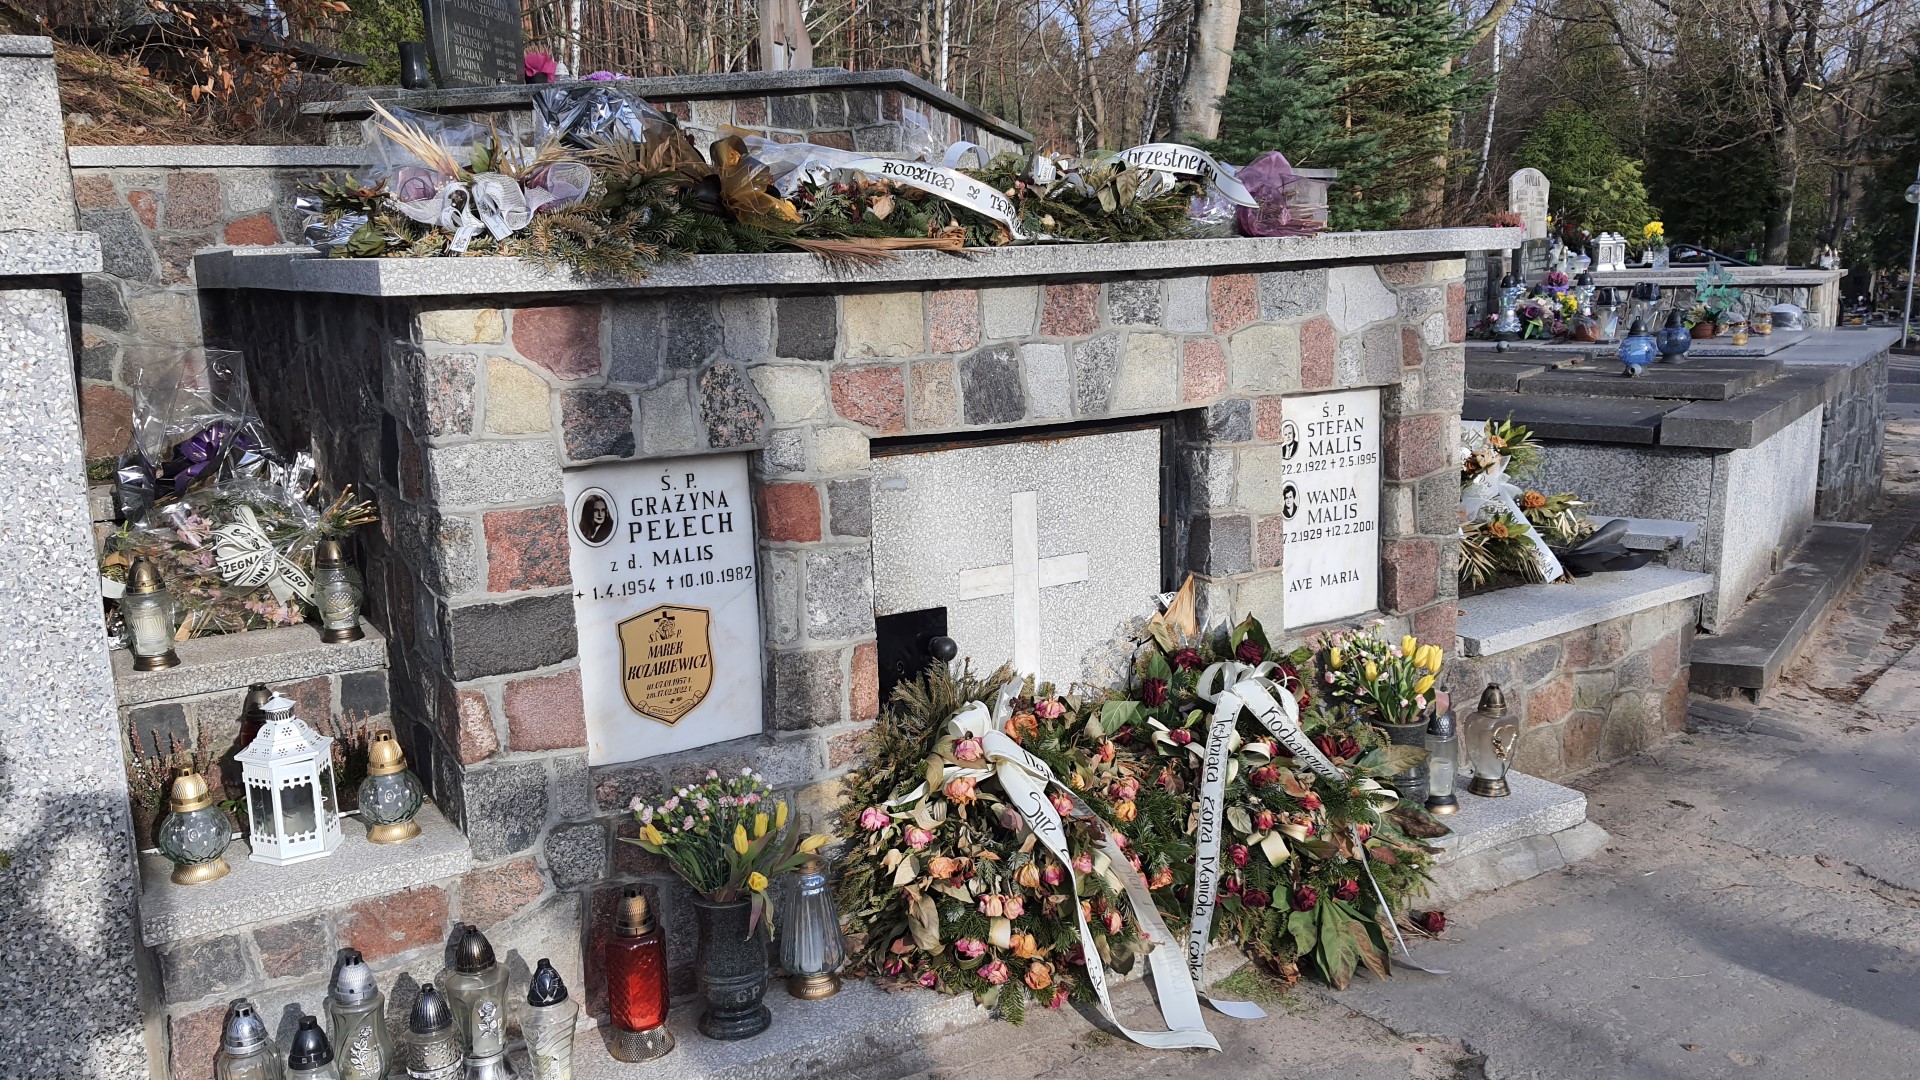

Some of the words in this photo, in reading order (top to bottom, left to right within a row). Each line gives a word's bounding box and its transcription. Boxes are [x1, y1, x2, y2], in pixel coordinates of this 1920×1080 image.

[453, 22, 489, 40] WIKTORIA
[455, 45, 484, 61] BOGDAN
[456, 58, 481, 72] JANINA
[1307, 417, 1364, 438] STEFAN
[1308, 435, 1362, 457] MALIS
[1339, 452, 1377, 468] 2.5.1995
[661, 469, 677, 491] Ś.
[685, 473, 697, 489] P.
[631, 490, 730, 517] GRAŻYNA
[1306, 486, 1357, 505] WANDA
[1307, 503, 1358, 525] MALIS
[628, 511, 734, 544] PEŁECH
[1332, 520, 1374, 537] 12.2.2001
[610, 561, 619, 572] z
[628, 553, 642, 569] d.
[652, 544, 714, 567] MALIS
[593, 578, 656, 600] 1.4.1954
[680, 565, 753, 588] 10.10.1982
[1289, 577, 1313, 593] AVE
[1320, 568, 1360, 587] MARIA
[647, 641, 684, 660] MAREK
[627, 653, 708, 681] KOZAKIEWICZ
[1260, 706, 1334, 777] Kochanemu
[1017, 791, 1057, 836] Syn
